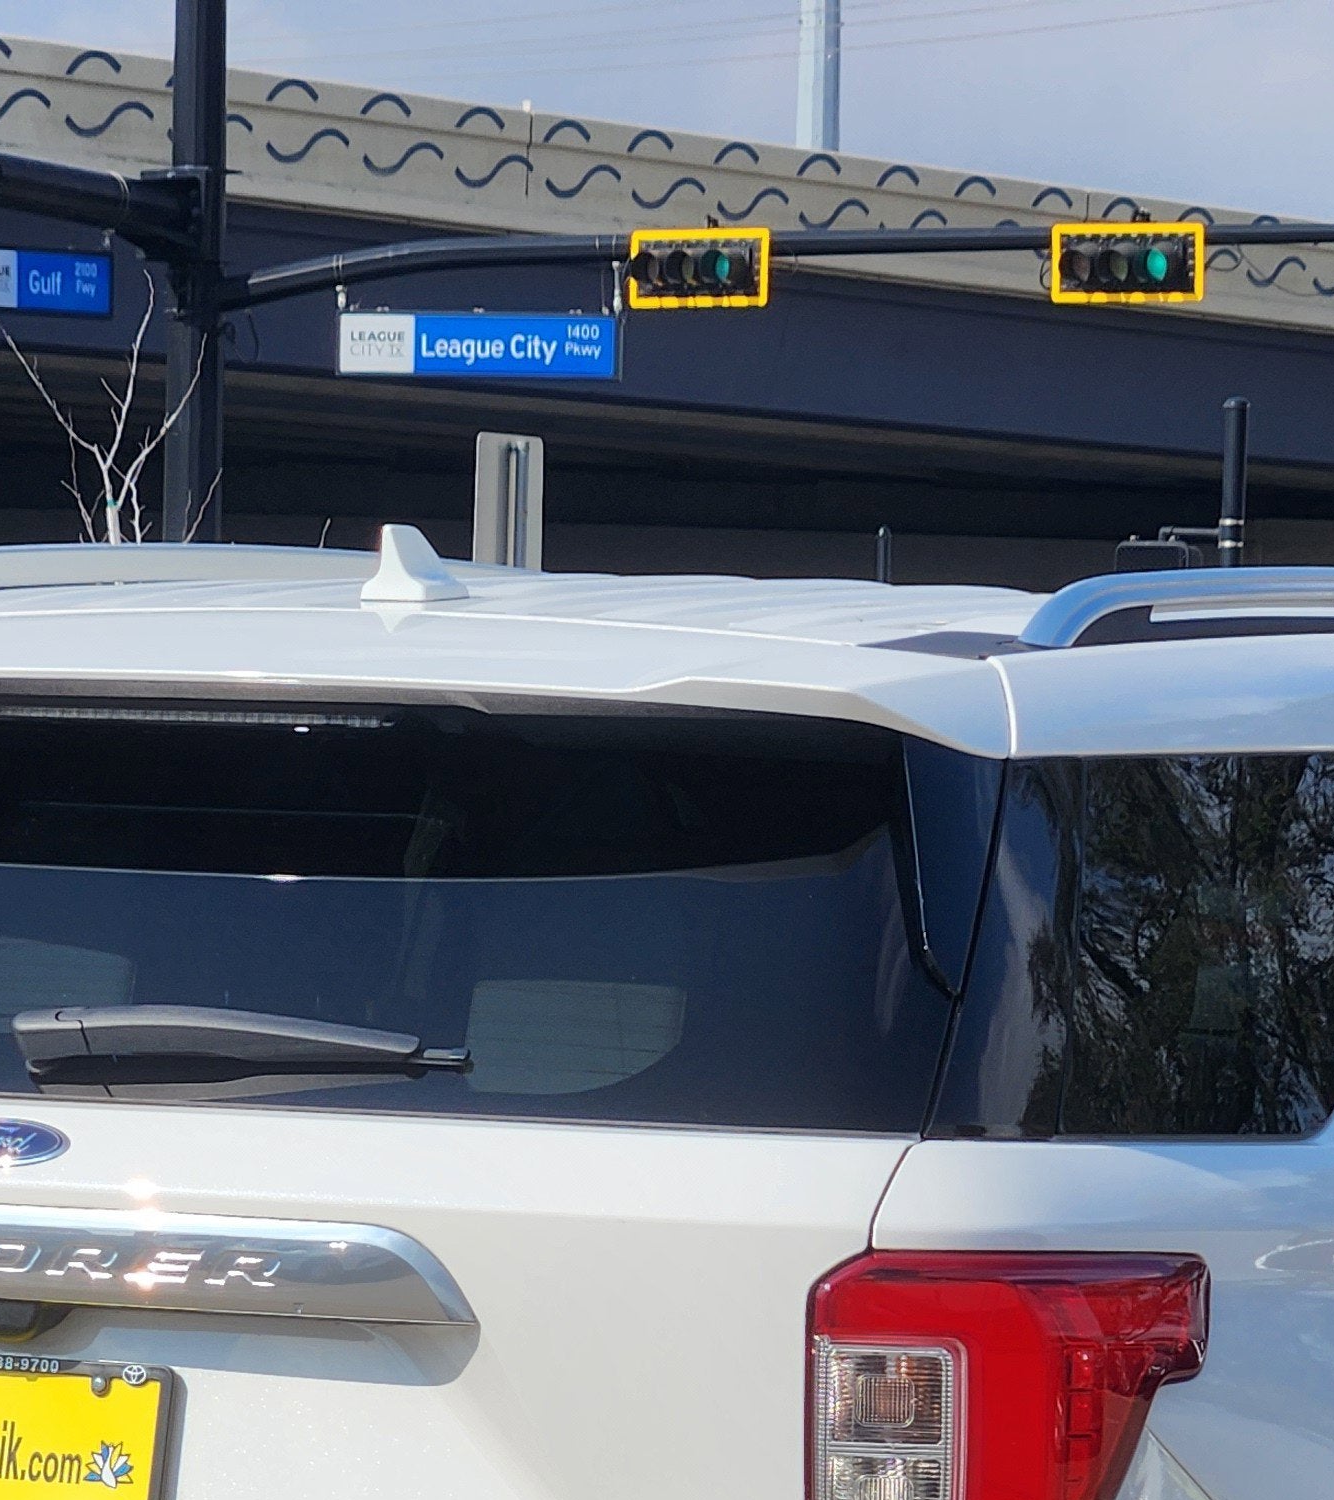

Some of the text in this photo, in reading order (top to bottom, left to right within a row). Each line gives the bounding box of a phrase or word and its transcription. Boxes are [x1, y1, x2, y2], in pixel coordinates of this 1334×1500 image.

[74, 261, 98, 278] 2100
[28, 269, 62, 296] Gulf
[75, 279, 97, 298] Fwy
[350, 330, 405, 342] LEAGUE
[567, 323, 600, 340] 1400
[350, 343, 384, 356] CITY
[420, 332, 558, 367] League City
[564, 341, 602, 360] Pkwy
